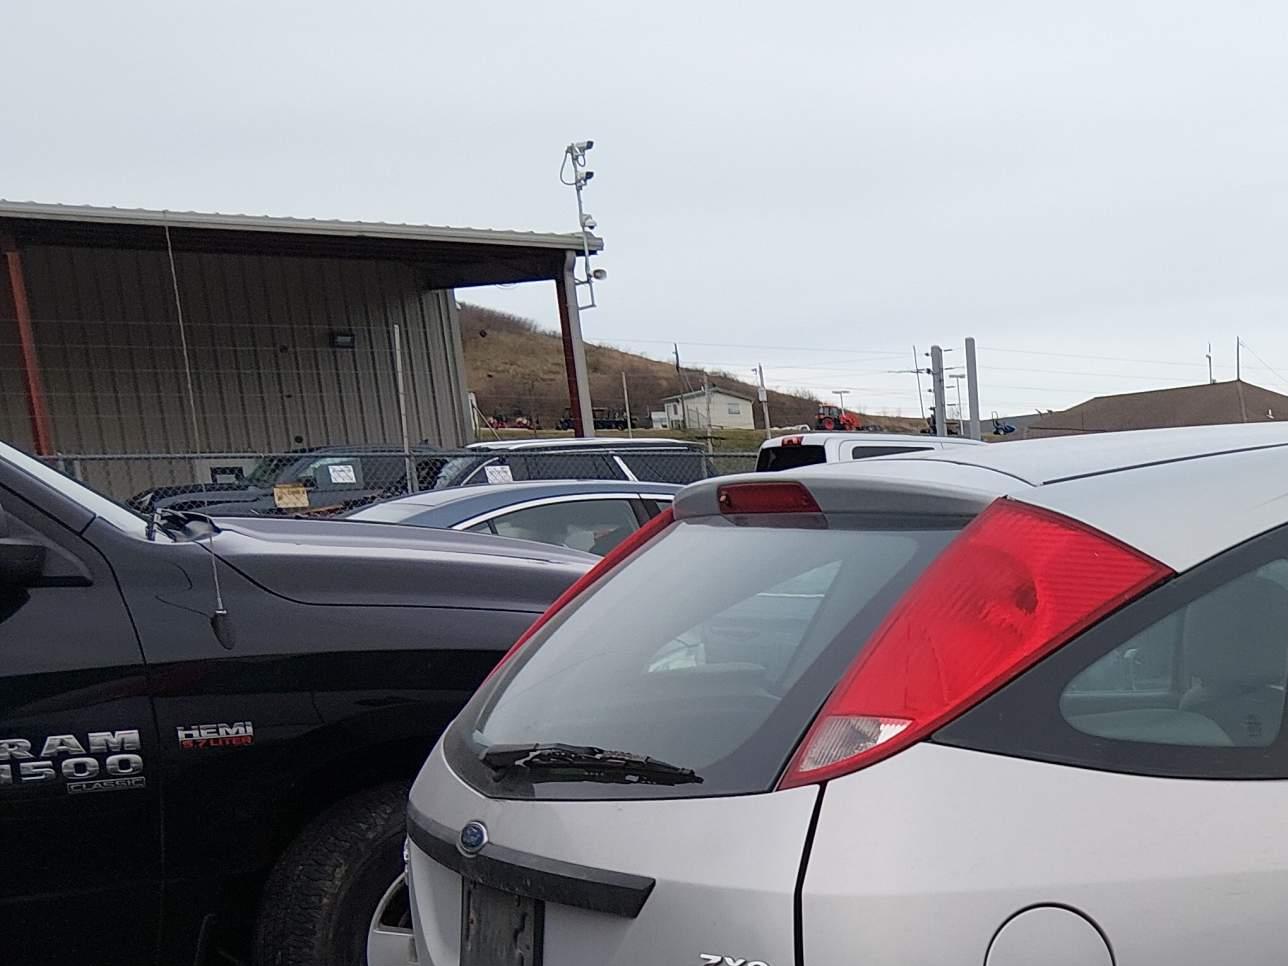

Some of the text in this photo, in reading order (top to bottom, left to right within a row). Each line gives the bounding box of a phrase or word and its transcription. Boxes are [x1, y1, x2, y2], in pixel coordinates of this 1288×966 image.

[176, 721, 254, 740] HEMI
[0, 729, 142, 761] RAM
[209, 736, 253, 747] LITER
[0, 753, 144, 784] 1500
[69, 777, 145, 793] CLASSIC
